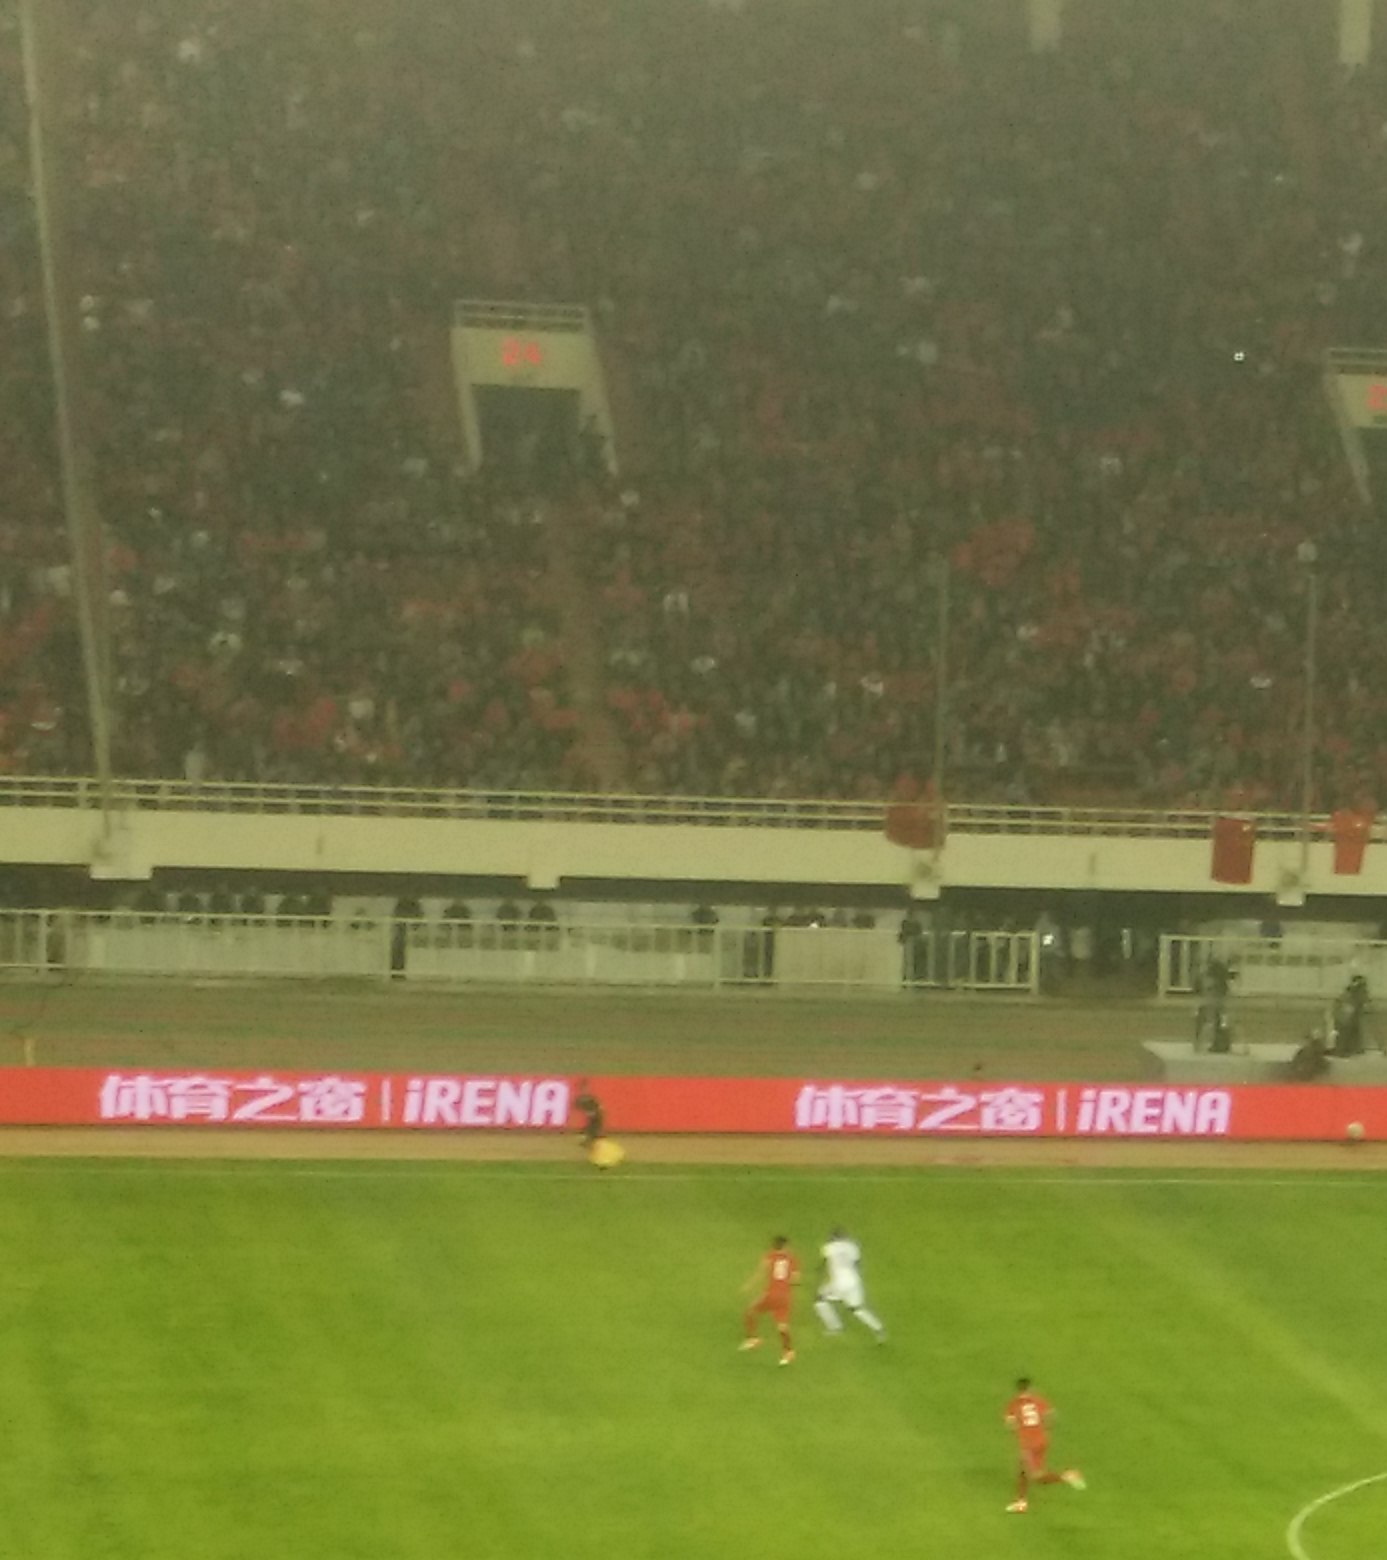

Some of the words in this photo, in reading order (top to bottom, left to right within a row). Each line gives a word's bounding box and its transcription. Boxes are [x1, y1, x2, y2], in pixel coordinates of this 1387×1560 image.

[99, 1073, 367, 1122] 体育之窗
[795, 1082, 1044, 1131] 体育之窗
